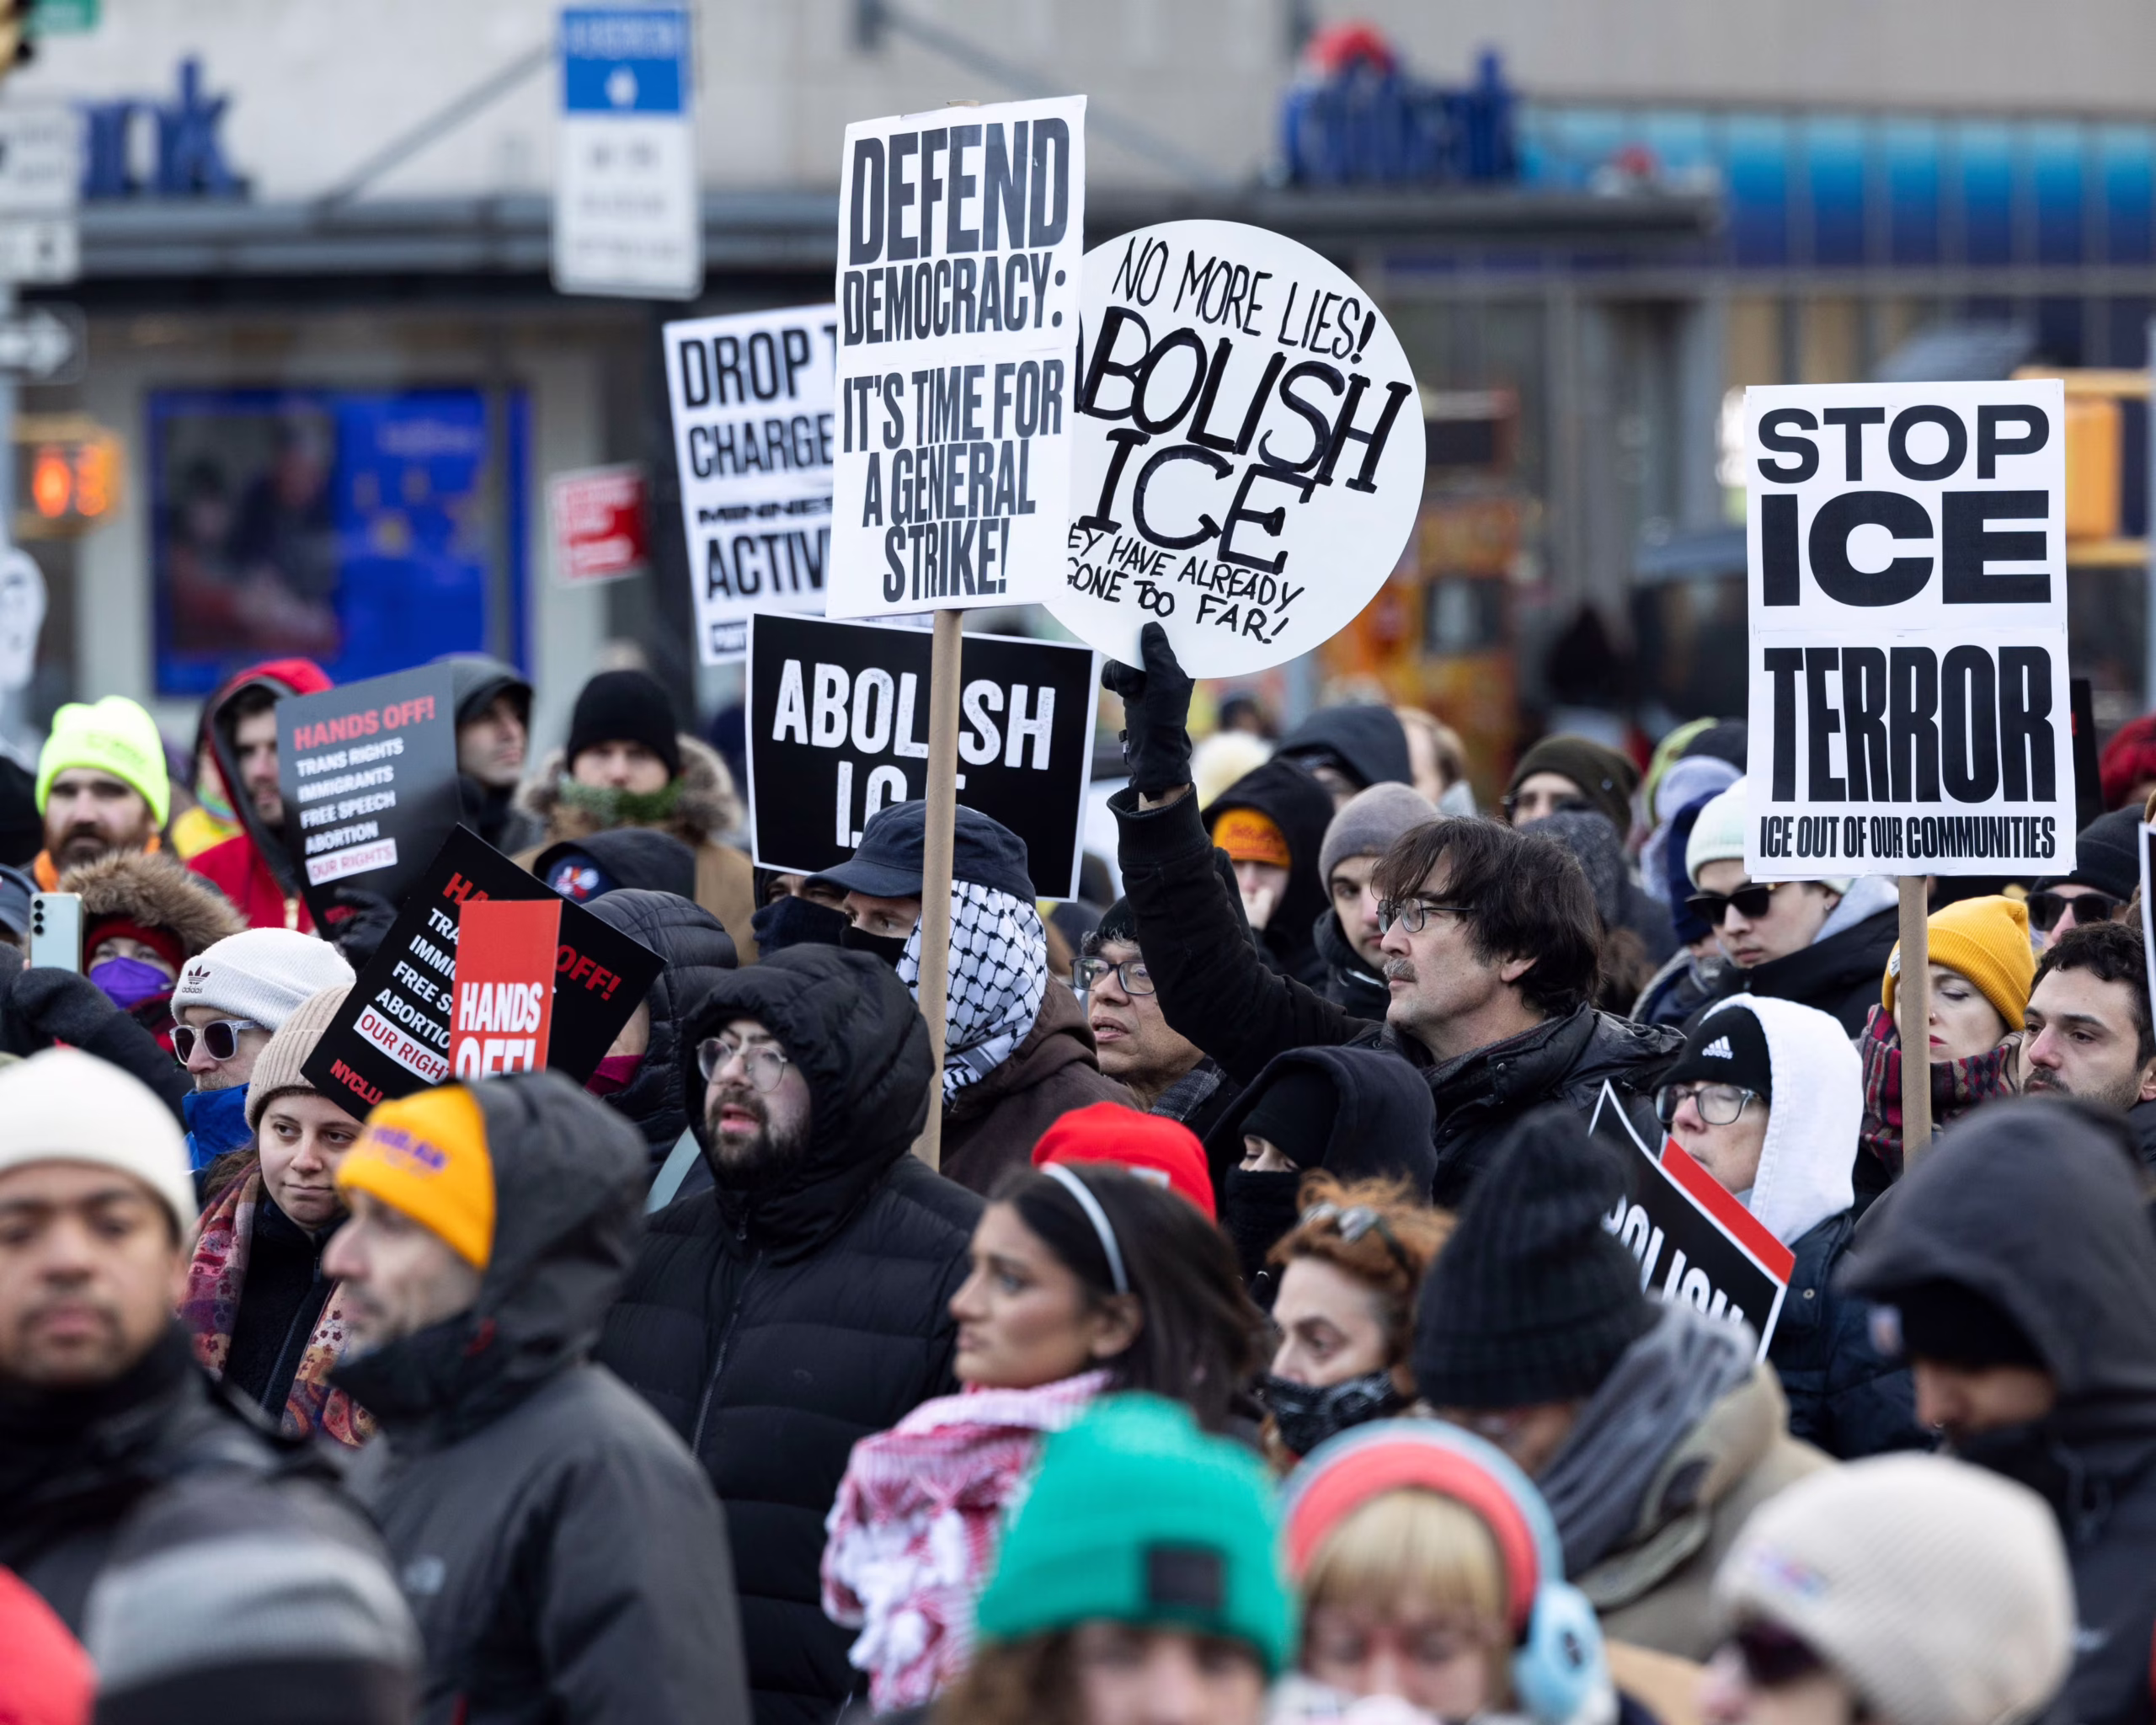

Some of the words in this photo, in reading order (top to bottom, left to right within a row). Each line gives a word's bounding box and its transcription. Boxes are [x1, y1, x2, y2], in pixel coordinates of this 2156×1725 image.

[849, 117, 1070, 266] DEFEND
[843, 252, 1066, 347] DEMOCRACY:
[1112, 237, 1169, 306] NO
[1173, 250, 1273, 336] MORE
[1278, 281, 1376, 364] LIES!
[679, 328, 812, 409] DROP
[1075, 306, 1412, 494] BOLISH
[843, 371, 904, 453] IT'S
[911, 364, 985, 446] TIME
[993, 359, 1065, 440] FOR
[688, 414, 834, 478] CHARGE
[1758, 404, 2050, 484] STOP
[862, 451, 883, 528] A
[890, 439, 1036, 526] GENERAL
[1079, 428, 1315, 575] ICE
[883, 517, 1010, 603] STRIKE!
[1107, 536, 1177, 576] HAVE
[1177, 556, 1305, 614] ALREADY
[1761, 489, 2052, 606] ICE
[1134, 580, 1175, 617] TOO
[1196, 594, 1289, 644] FAR!
[293, 709, 380, 751] HANDS
[382, 695, 435, 730] OFF!
[772, 659, 1056, 770] ABOLSH
[1764, 645, 2057, 804] TERROR
[296, 750, 348, 777] TRANS
[348, 737, 404, 766] RIGHTS
[297, 765, 394, 803] IMMIGRANTS
[300, 804, 337, 830] FREE
[338, 790, 397, 820] SPEECH
[305, 820, 379, 855] ABORTION
[835, 761, 966, 848] IC
[1759, 815, 1794, 858] ICE
[1796, 815, 1839, 858] OUT
[1843, 815, 1867, 858] OF
[1870, 815, 1903, 859] OUR
[1906, 815, 2056, 859] COMMUNITIES
[312, 859, 339, 879] OUR
[340, 845, 392, 870] RIGHTS
[181, 985, 203, 994] adidas
[392, 960, 439, 1002] FREE
[458, 981, 544, 1033] HANDS
[555, 944, 622, 1001] OFF!
[329, 1058, 384, 1106] NYCLU
[360, 1014, 398, 1050] OUR
[398, 1042, 449, 1080] RIGH
